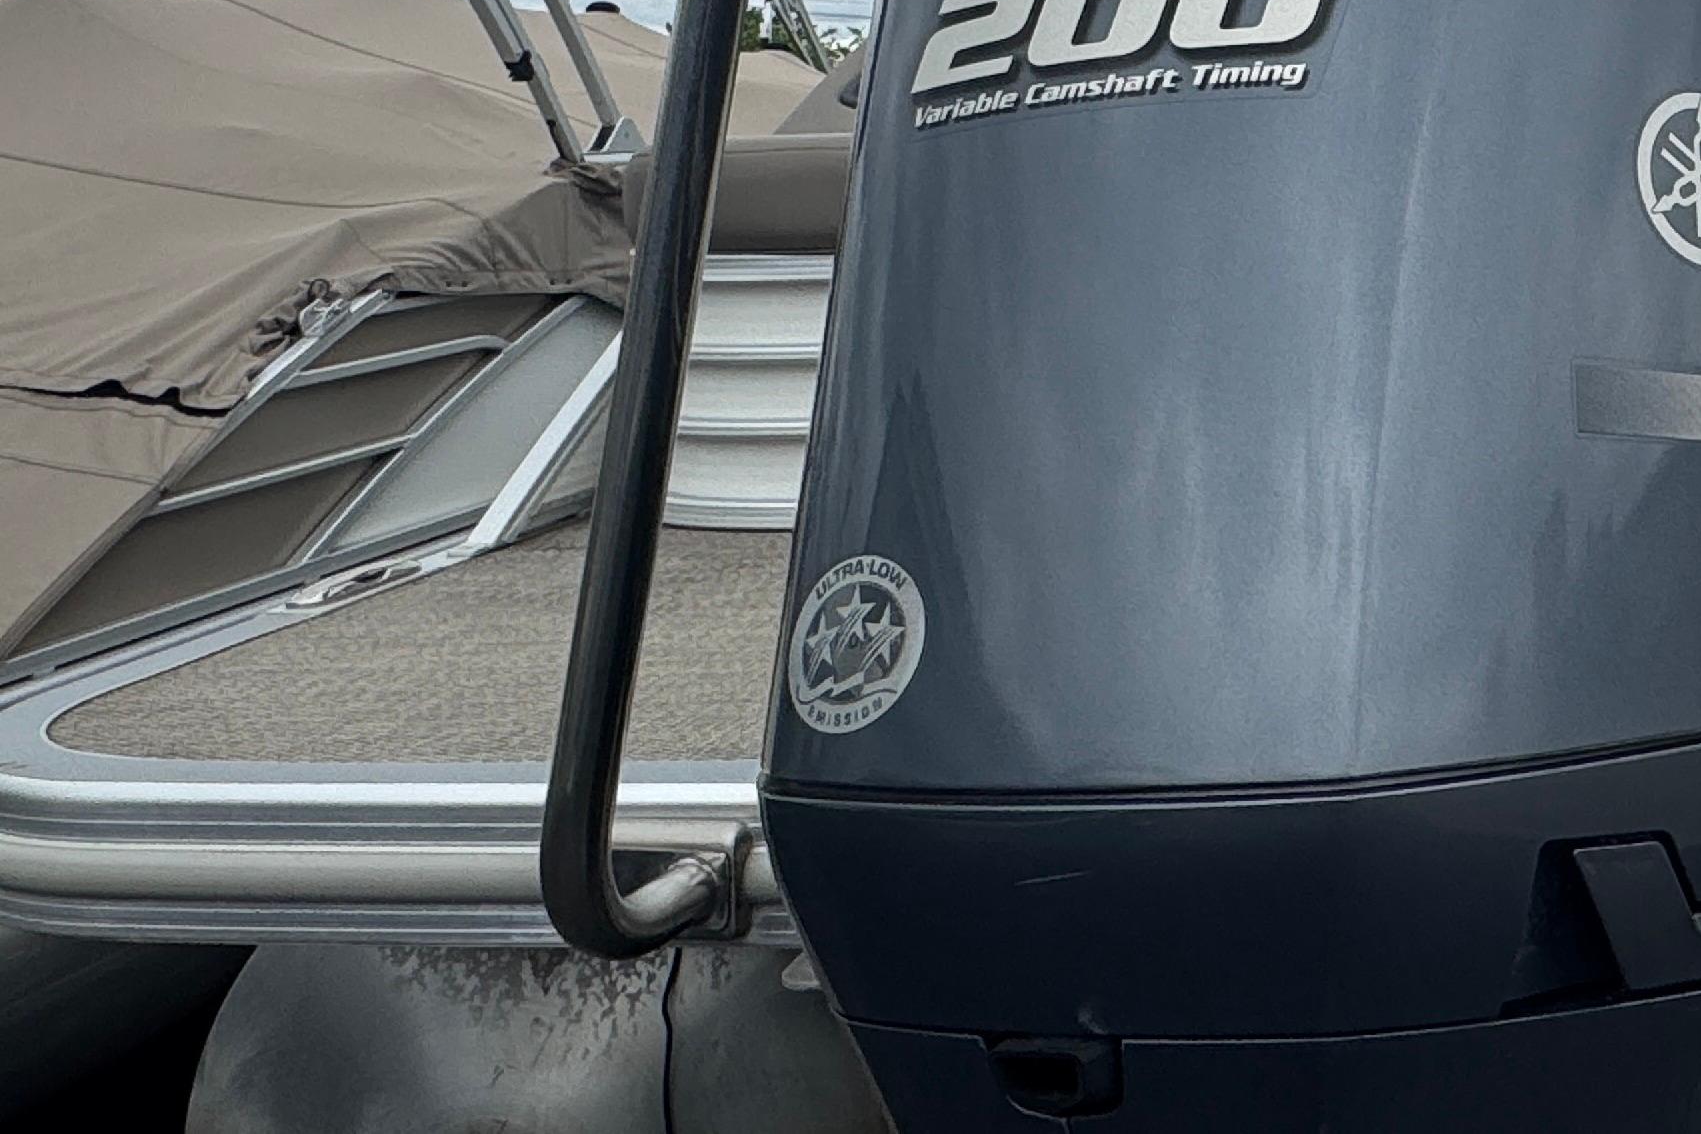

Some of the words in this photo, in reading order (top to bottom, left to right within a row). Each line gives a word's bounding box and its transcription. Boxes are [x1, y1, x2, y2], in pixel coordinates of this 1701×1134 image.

[914, 89, 1020, 129] Variable
[1024, 68, 1179, 106] Camshaft
[1192, 61, 1307, 87] Timing
[807, 696, 883, 727] EMISSION
